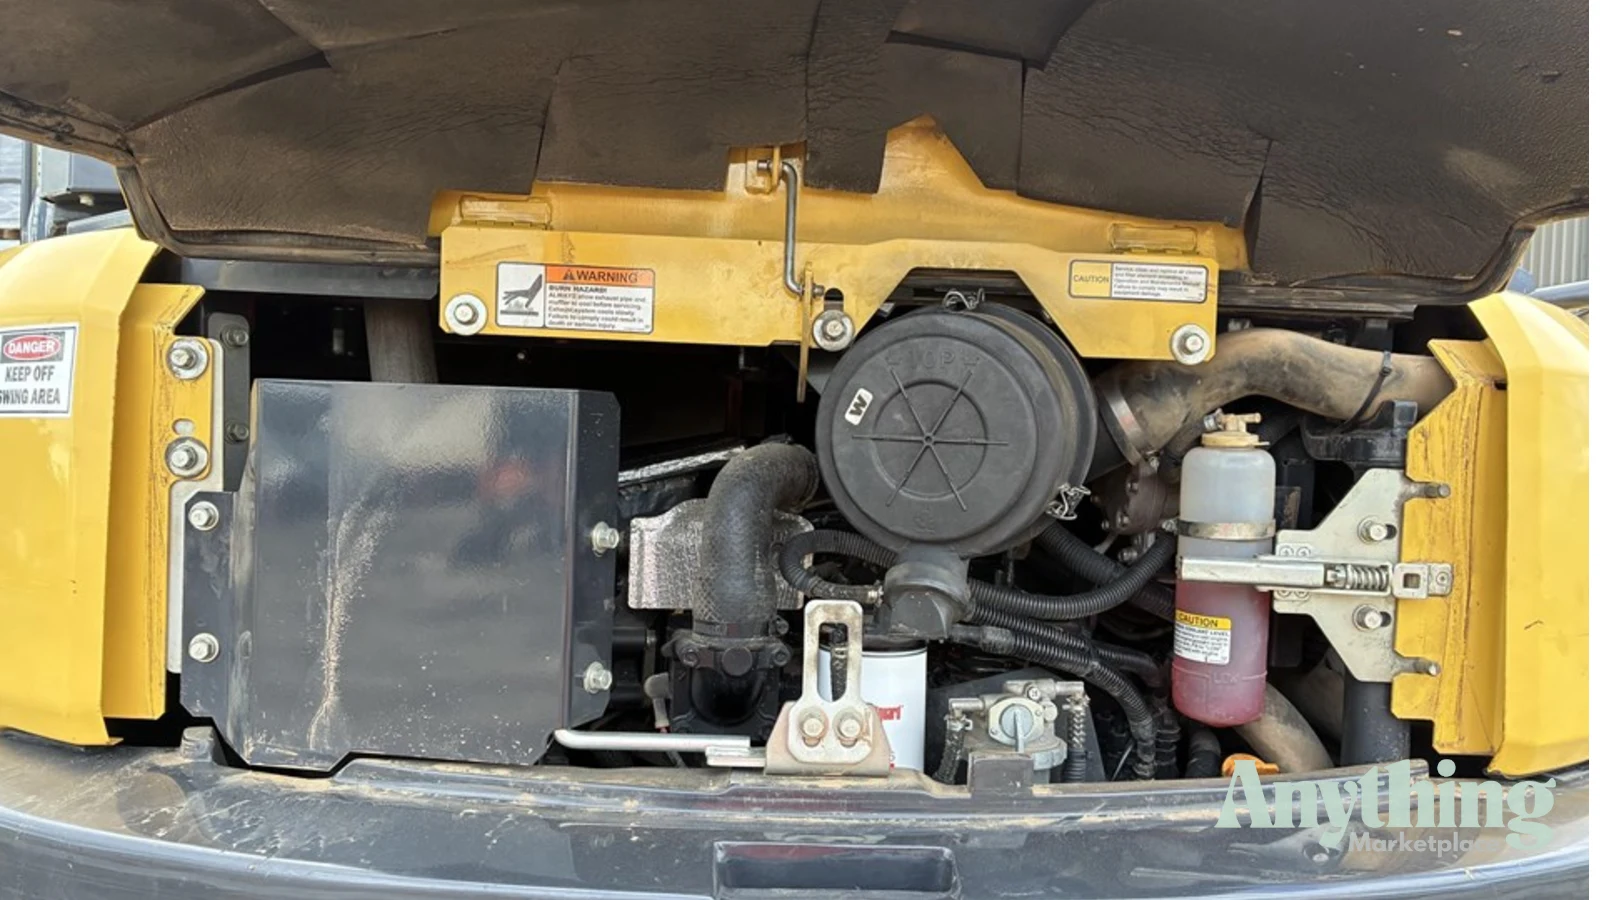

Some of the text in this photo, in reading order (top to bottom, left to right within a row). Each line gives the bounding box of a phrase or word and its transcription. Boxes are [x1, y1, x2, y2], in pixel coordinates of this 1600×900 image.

[576, 269, 638, 283] WARNING
[1073, 274, 1110, 284] CAUTION
[8, 340, 56, 355] DANGER
[5, 365, 56, 382] KEEP OFF
[30, 387, 61, 405] AREA
[1178, 612, 1218, 628] CAUTION
